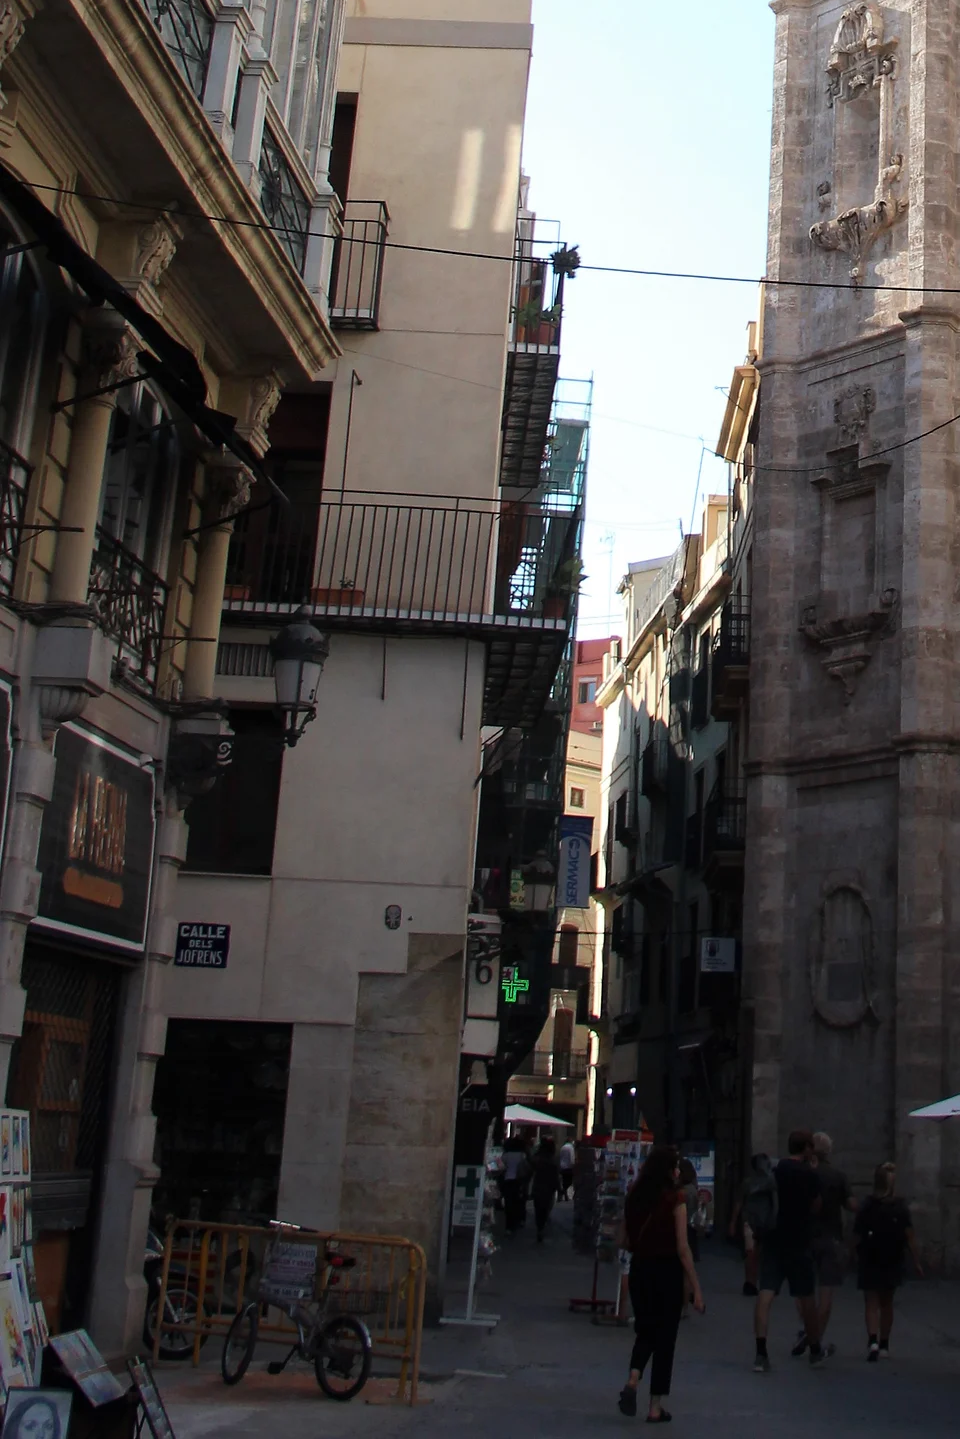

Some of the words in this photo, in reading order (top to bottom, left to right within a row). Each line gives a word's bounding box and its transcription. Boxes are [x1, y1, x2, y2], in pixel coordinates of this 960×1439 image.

[180, 925, 227, 939] CALLE
[189, 939, 213, 948] DELS
[176, 949, 223, 965] JOFRENS
[475, 959, 493, 985] 6
